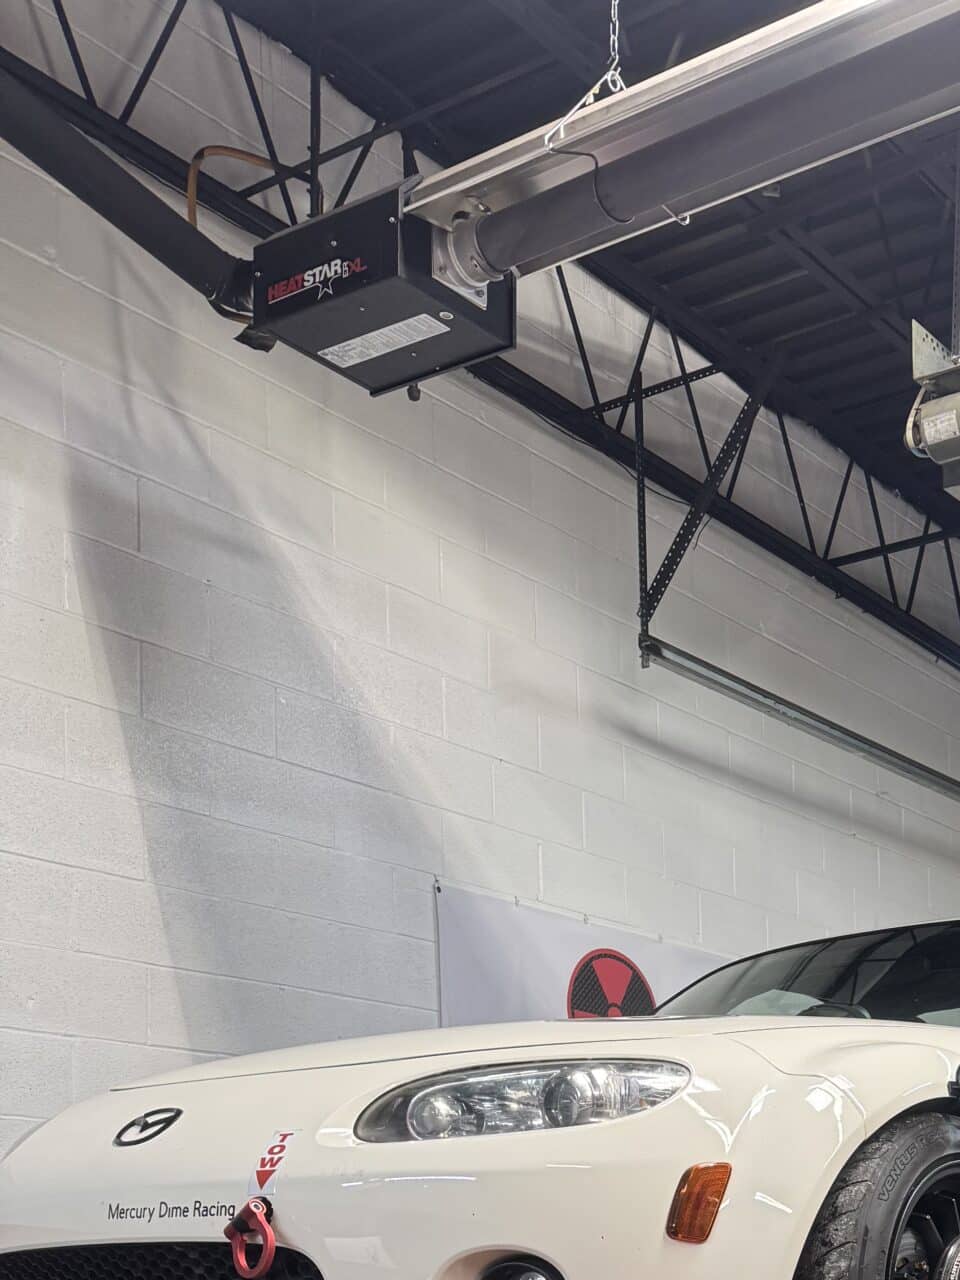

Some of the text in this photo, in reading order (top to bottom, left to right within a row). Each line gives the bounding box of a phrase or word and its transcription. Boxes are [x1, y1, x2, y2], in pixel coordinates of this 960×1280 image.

[259, 1132, 294, 1169] TOW
[107, 1200, 236, 1223] Mercury Dime Racing
